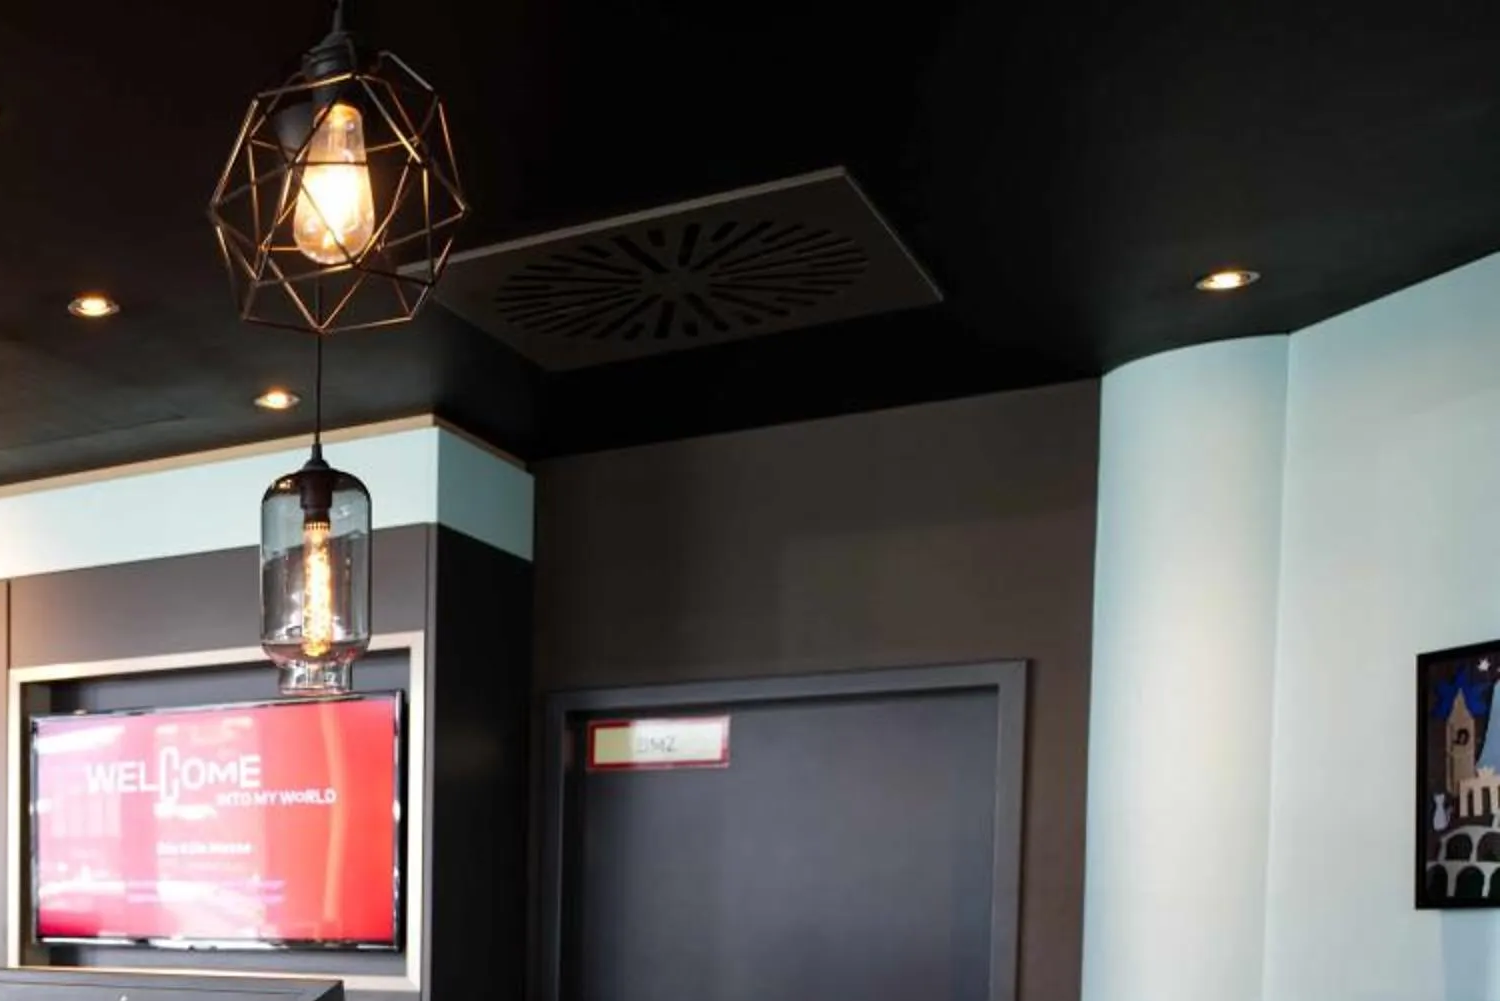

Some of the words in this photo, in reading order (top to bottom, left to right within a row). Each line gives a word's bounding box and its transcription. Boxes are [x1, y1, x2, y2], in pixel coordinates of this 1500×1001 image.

[85, 745, 261, 803] WELCOME
[252, 790, 278, 805] MY
[278, 787, 337, 805] WORLD
